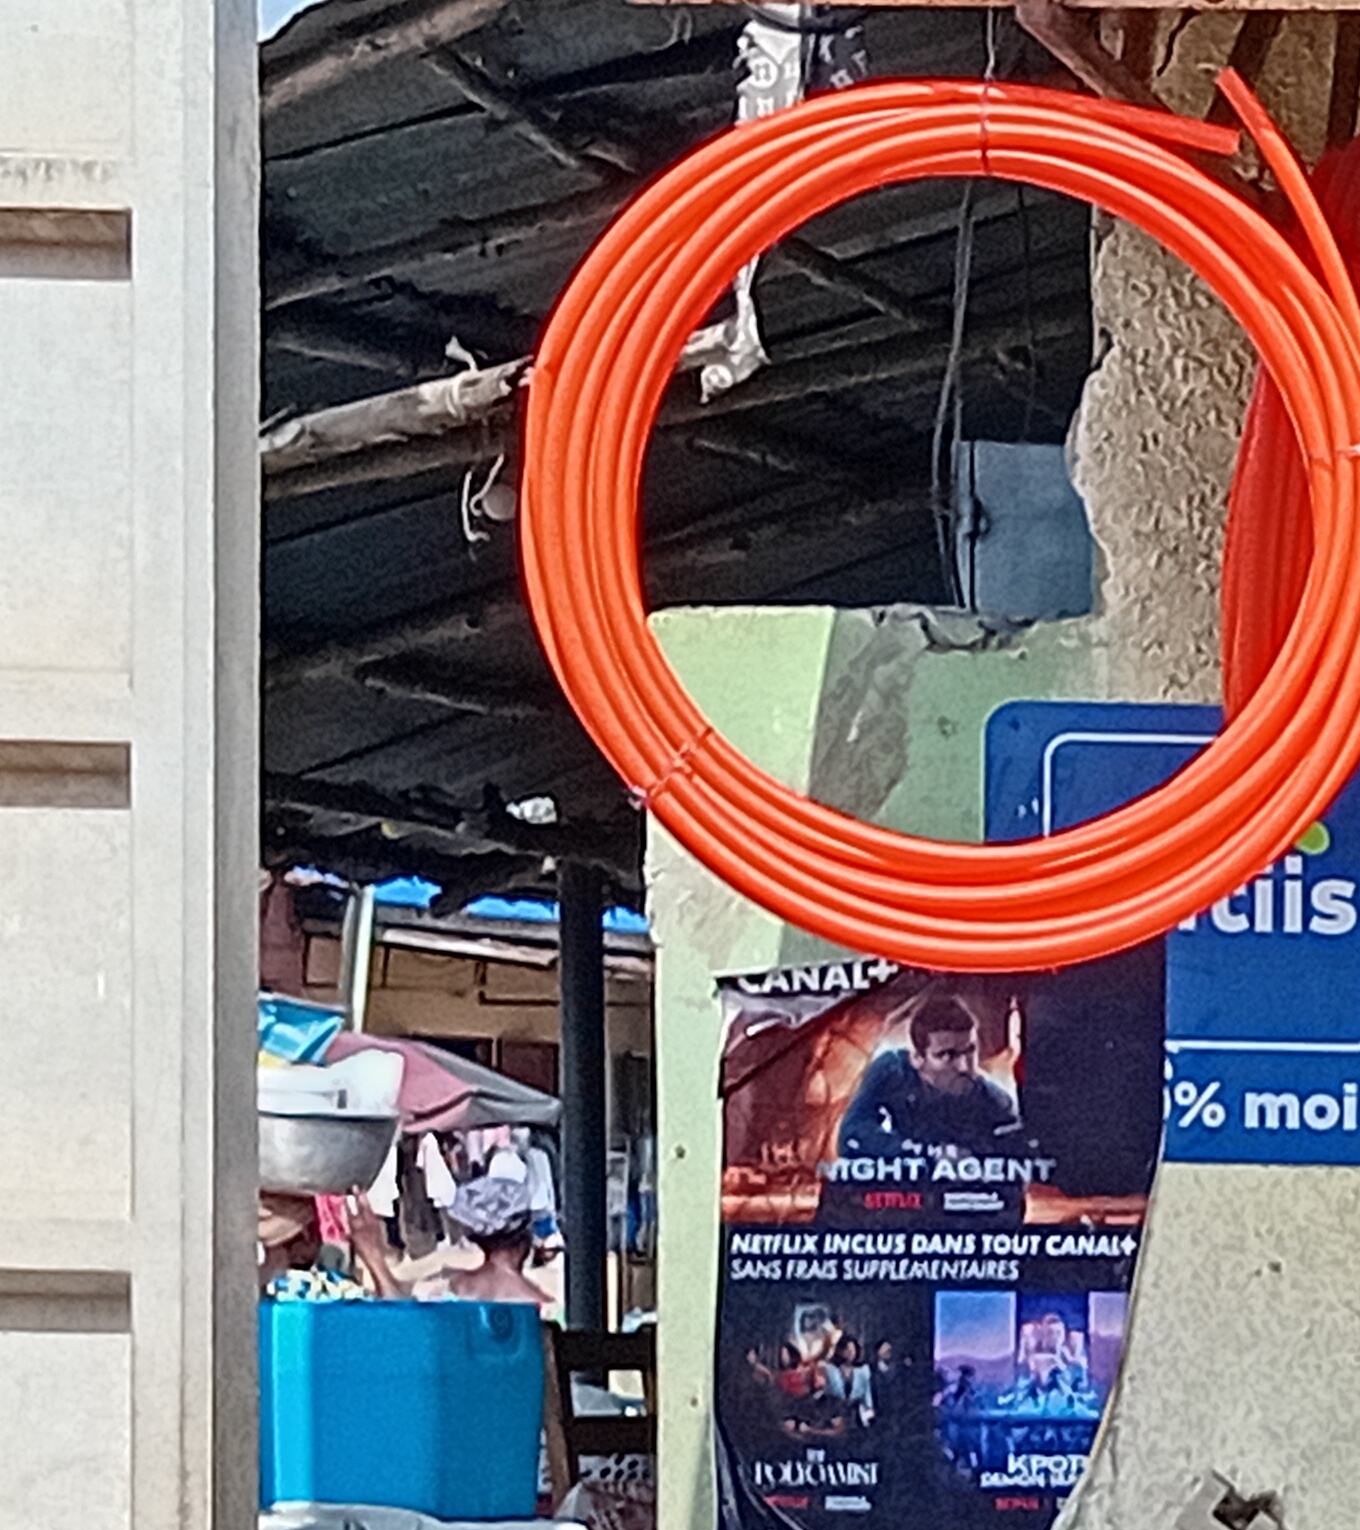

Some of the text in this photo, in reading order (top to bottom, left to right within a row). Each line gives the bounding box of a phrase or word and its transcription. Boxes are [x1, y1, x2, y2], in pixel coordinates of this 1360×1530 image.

[1244, 1082, 1358, 1131] moi
[931, 1157, 1057, 1183] AGENT
[731, 1233, 1138, 1257] NETFLIX INCLUS DANS TOUT CANAL+
[731, 1259, 782, 1281] SANS
[786, 1260, 838, 1280] FRAIS
